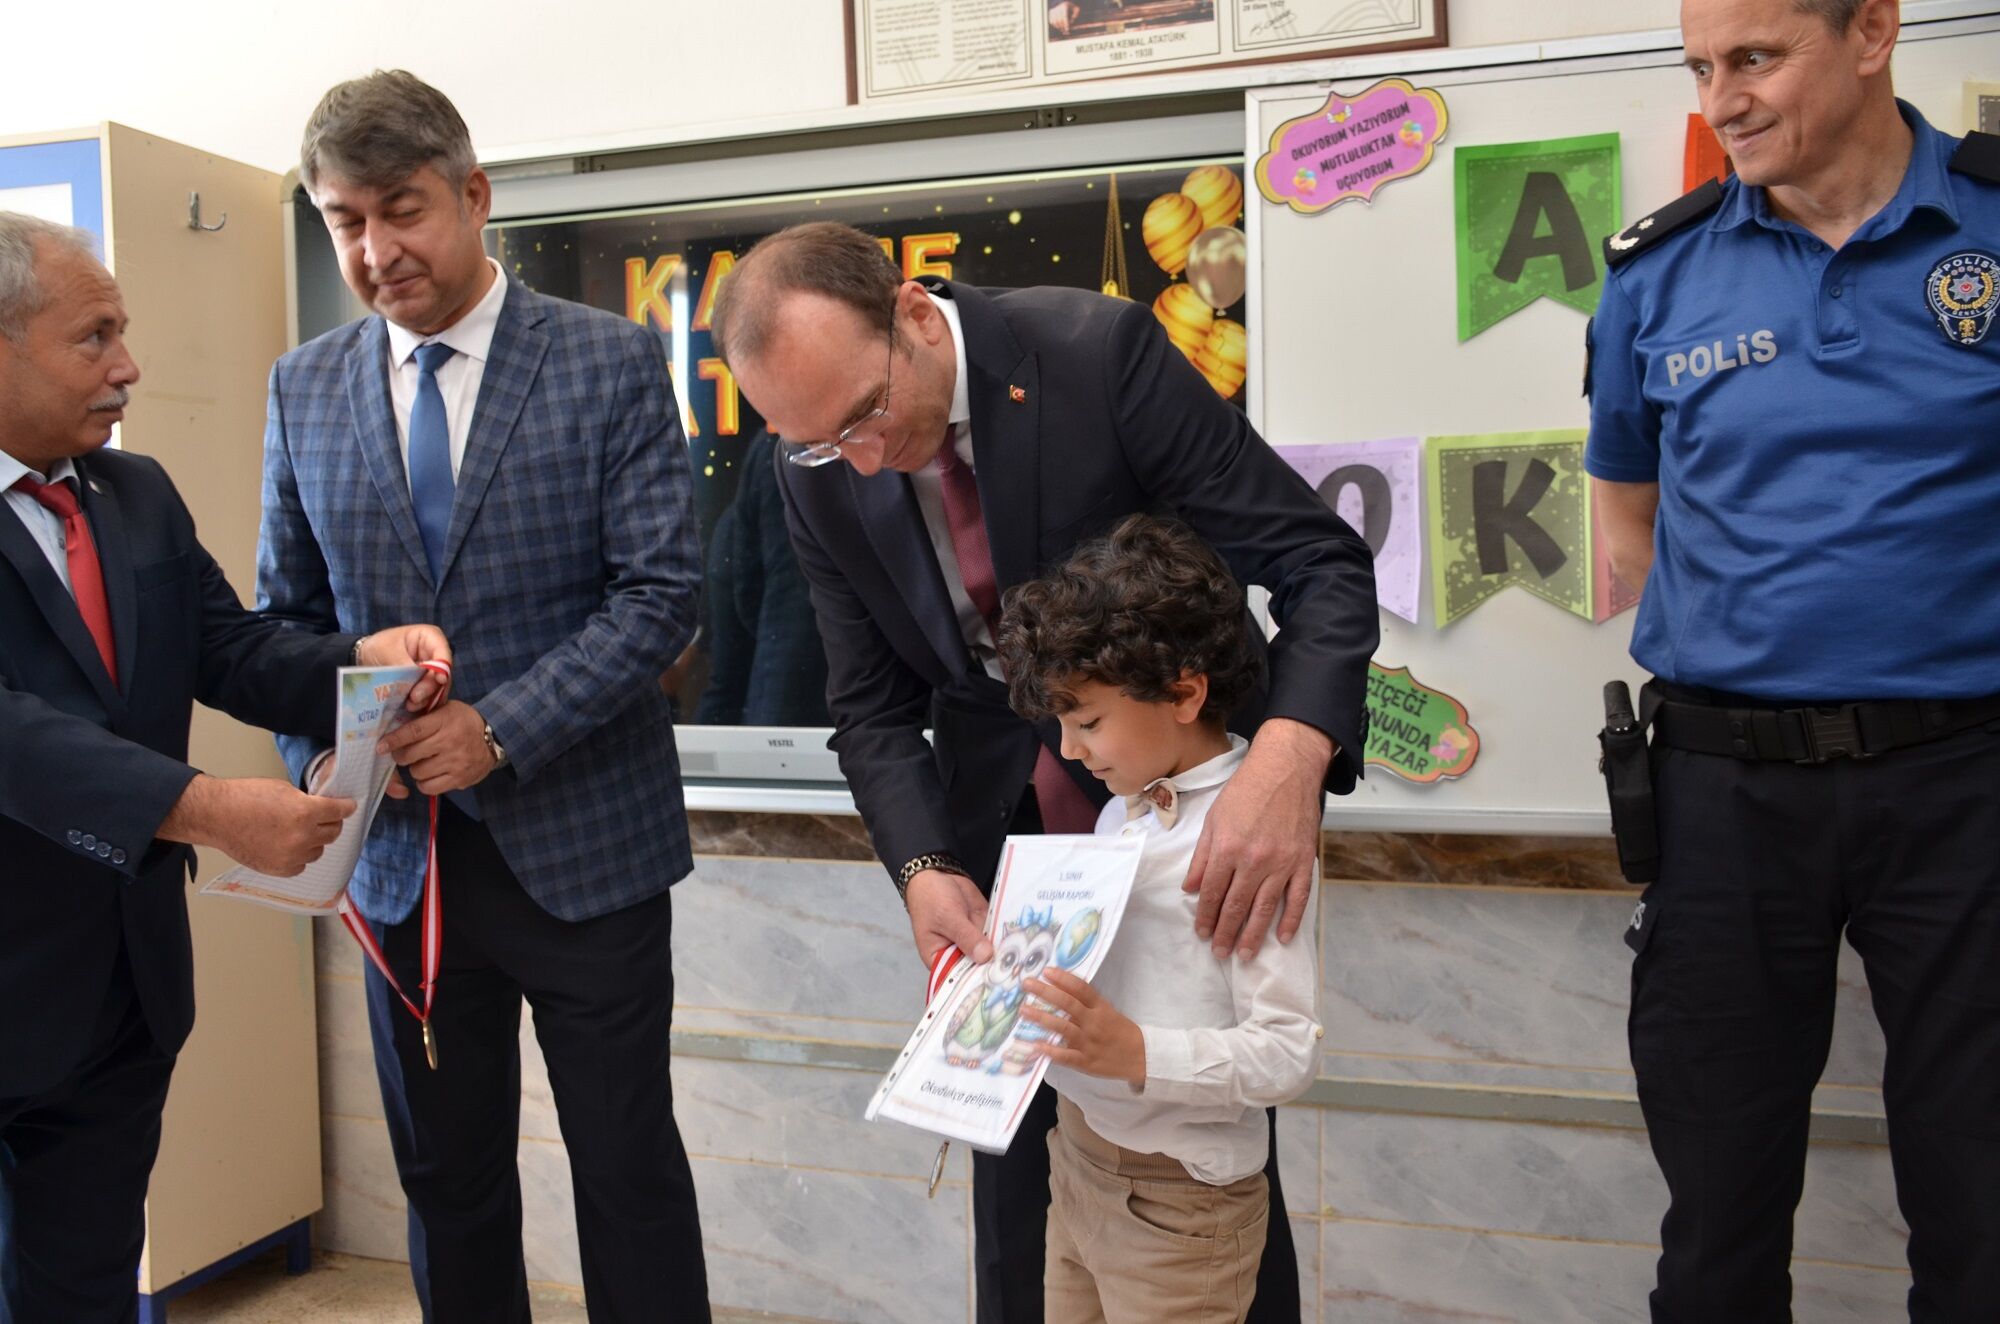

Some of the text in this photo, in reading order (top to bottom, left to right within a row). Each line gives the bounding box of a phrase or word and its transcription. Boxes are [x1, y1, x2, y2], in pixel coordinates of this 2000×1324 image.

[1075, 31, 1187, 53] MUSTAFA KEMAL ATATÜRK
[1291, 101, 1410, 161] OKUYORUM YAZIYORUM
[1319, 132, 1396, 174] MUTLULUKTAN
[1336, 157, 1394, 191] UÇUYORUM
[1369, 731, 1429, 775] YAZAR
